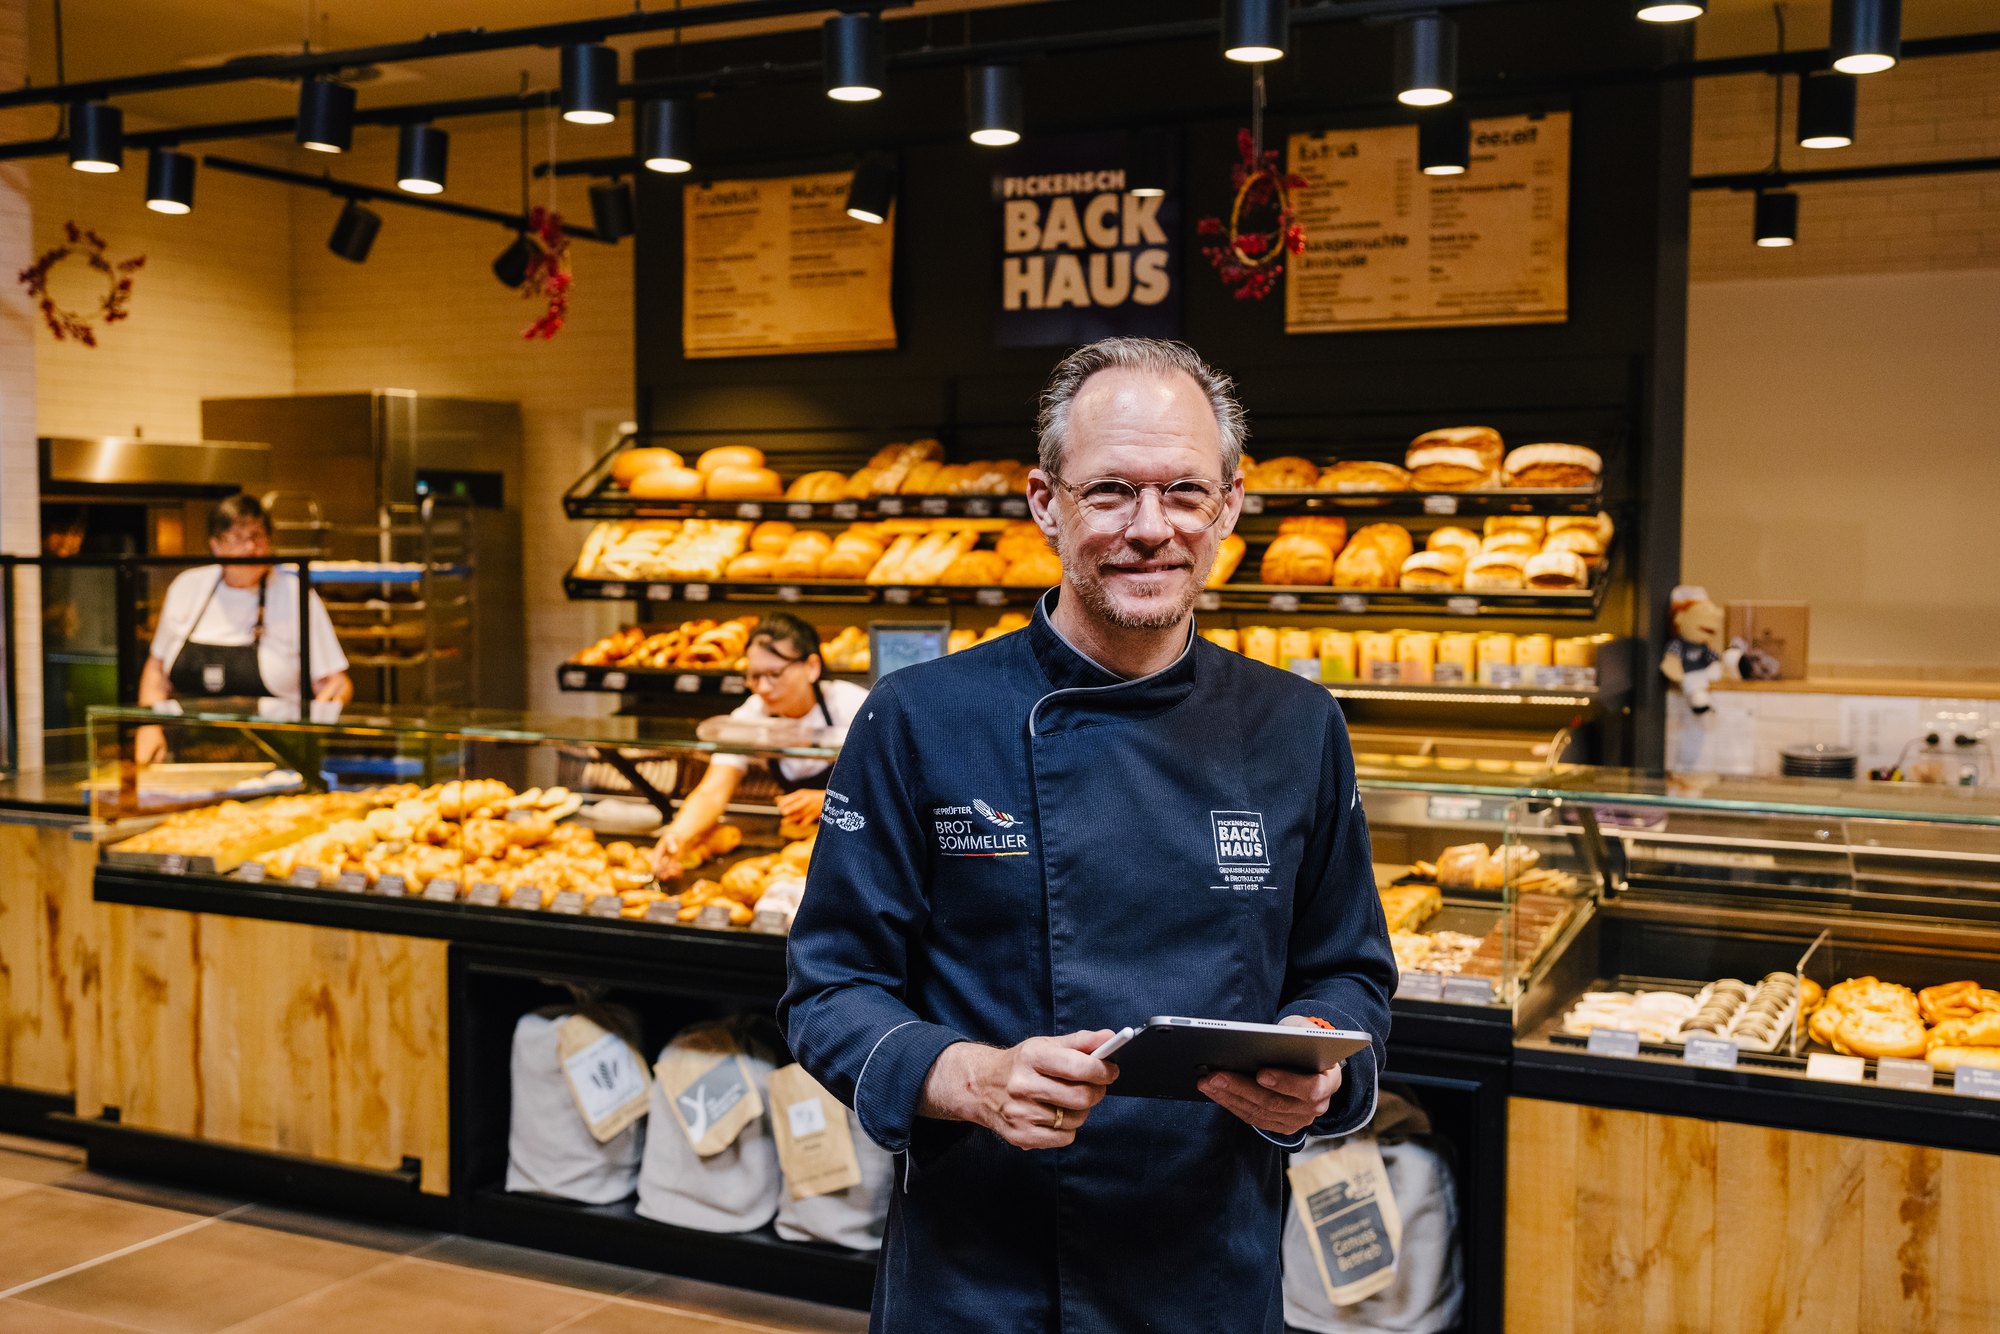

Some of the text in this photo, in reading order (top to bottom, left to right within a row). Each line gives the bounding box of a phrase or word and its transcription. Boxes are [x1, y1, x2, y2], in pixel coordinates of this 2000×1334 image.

[1002, 169, 1126, 197] FICKENSCH
[1004, 192, 1169, 253] BACK
[1003, 249, 1171, 311] HAUS
[933, 806, 973, 815] GEPRÜFTER
[935, 820, 973, 834] BROT
[1218, 827, 1261, 842] BACK
[938, 834, 1028, 850] SOMMELIER
[1220, 842, 1263, 857] HAUS
